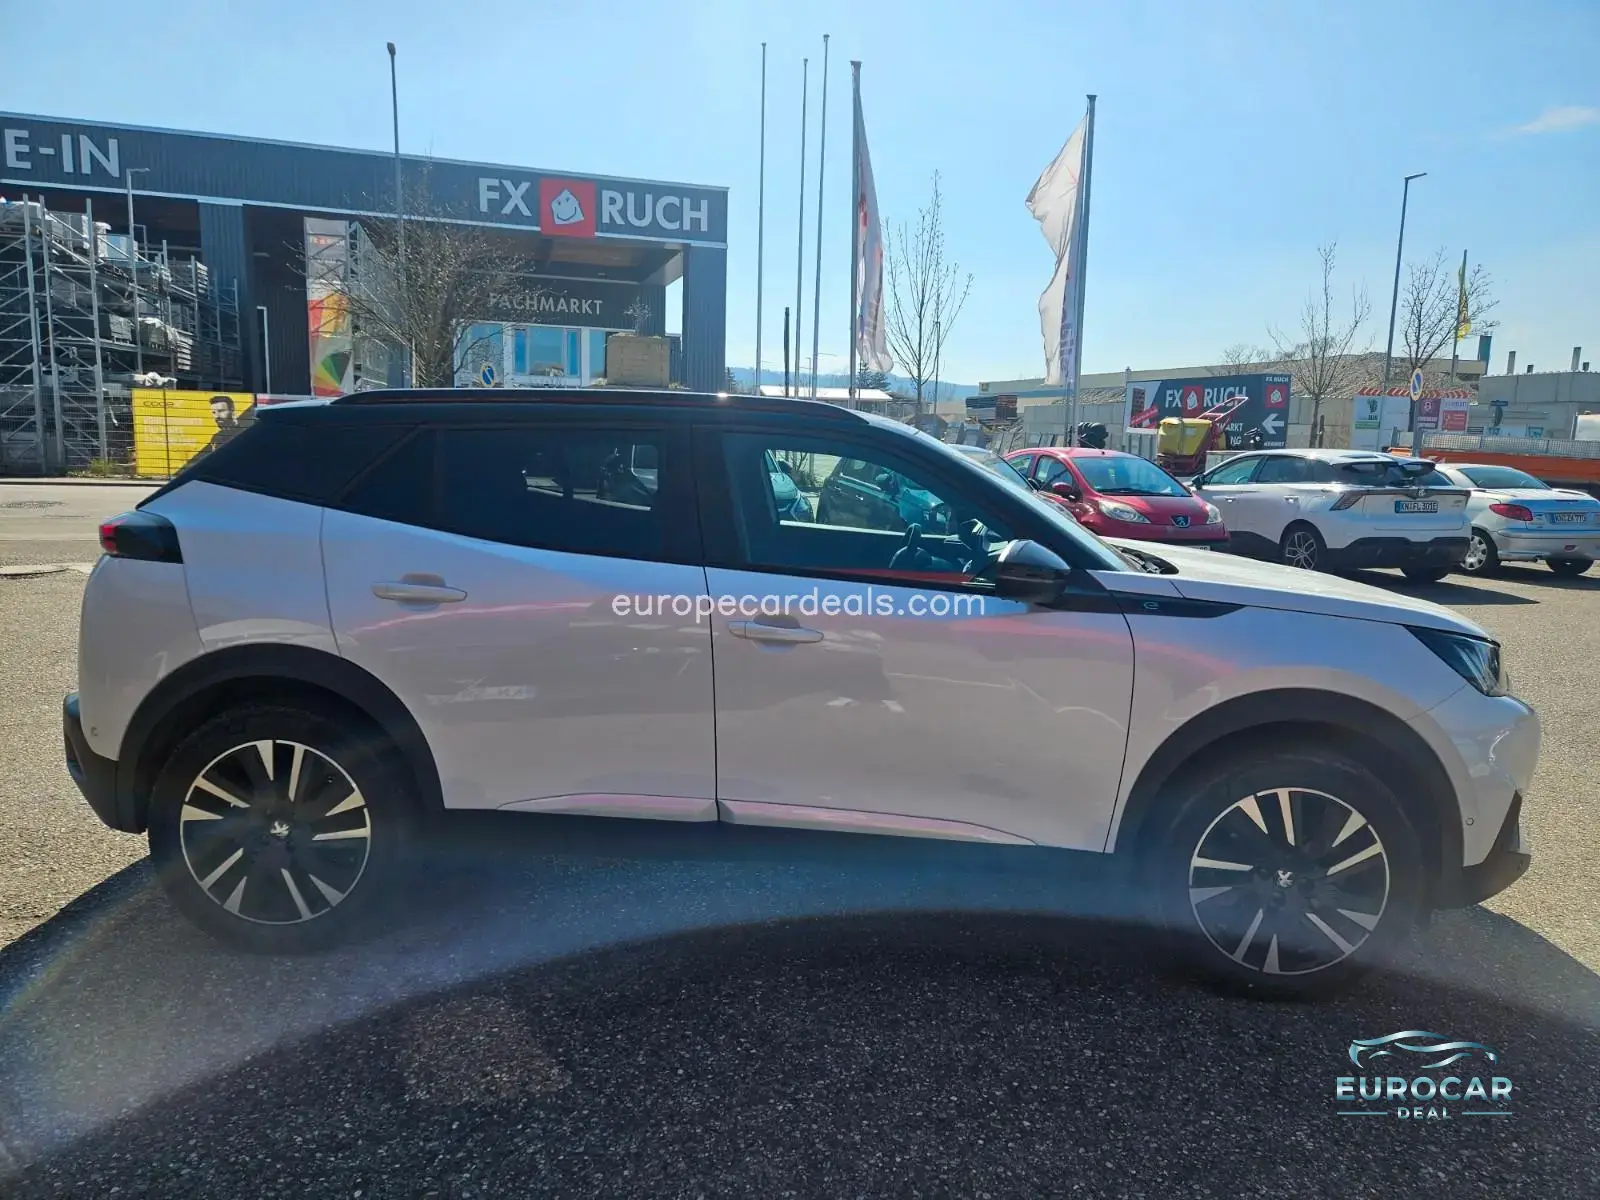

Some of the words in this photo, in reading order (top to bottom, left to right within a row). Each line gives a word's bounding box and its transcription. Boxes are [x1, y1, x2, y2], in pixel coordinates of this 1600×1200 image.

[4, 128, 120, 178] E-IN
[478, 177, 533, 217] FX
[601, 189, 709, 233] RUCH
[487, 292, 603, 315] FACHMARKT
[1165, 388, 1184, 408] FX
[1203, 385, 1247, 408] RUCH
